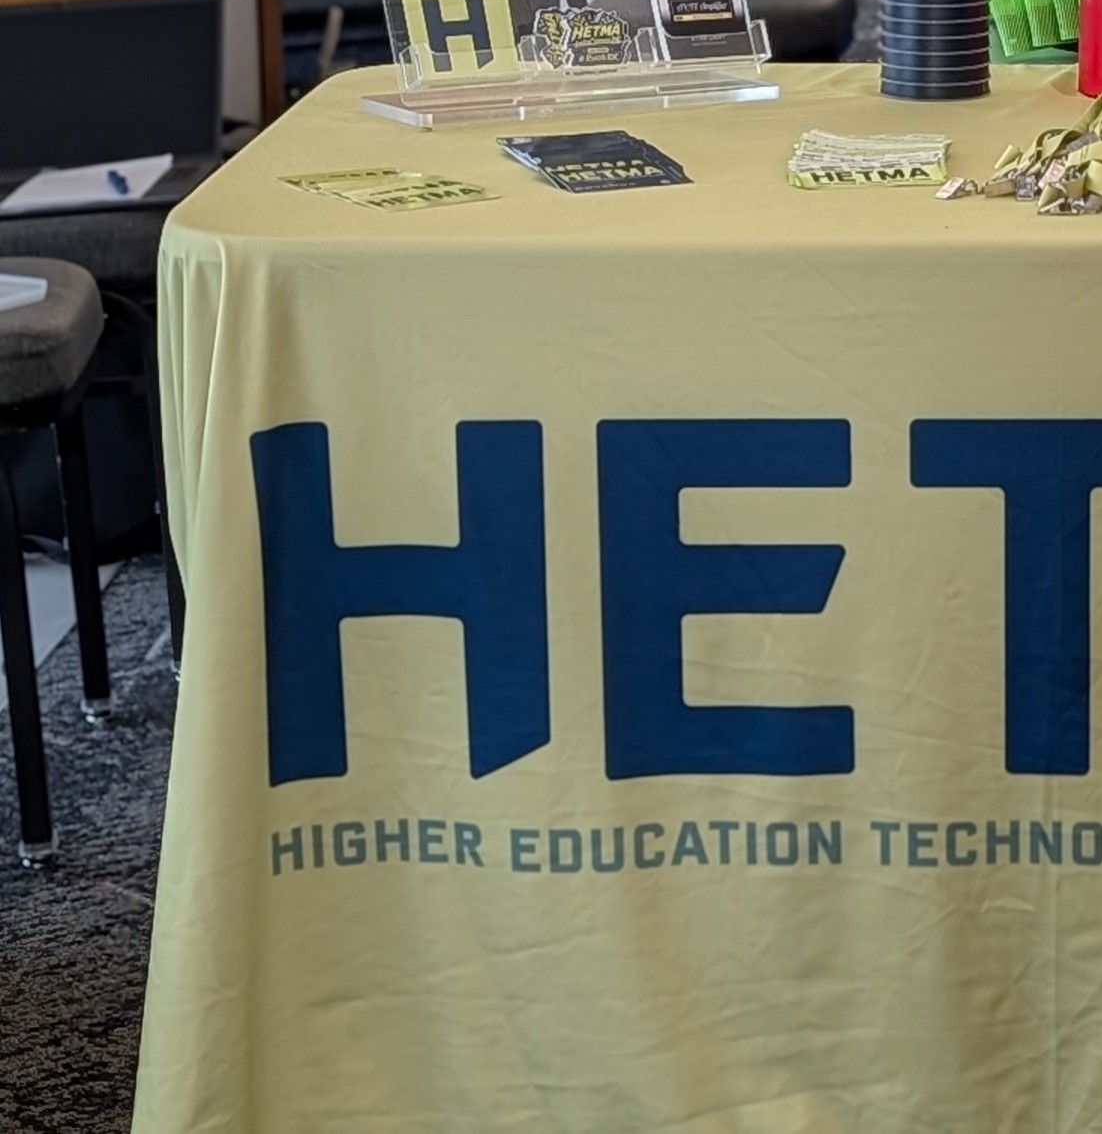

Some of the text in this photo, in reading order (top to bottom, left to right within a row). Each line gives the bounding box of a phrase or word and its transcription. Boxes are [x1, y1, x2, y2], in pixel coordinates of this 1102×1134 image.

[571, 23, 621, 43] HETMA
[557, 165, 666, 184] HETMA
[810, 167, 931, 183] HETMA
[367, 187, 483, 208] HETMA
[270, 817, 485, 876] HIGHER
[510, 819, 845, 874] EDUCATION
